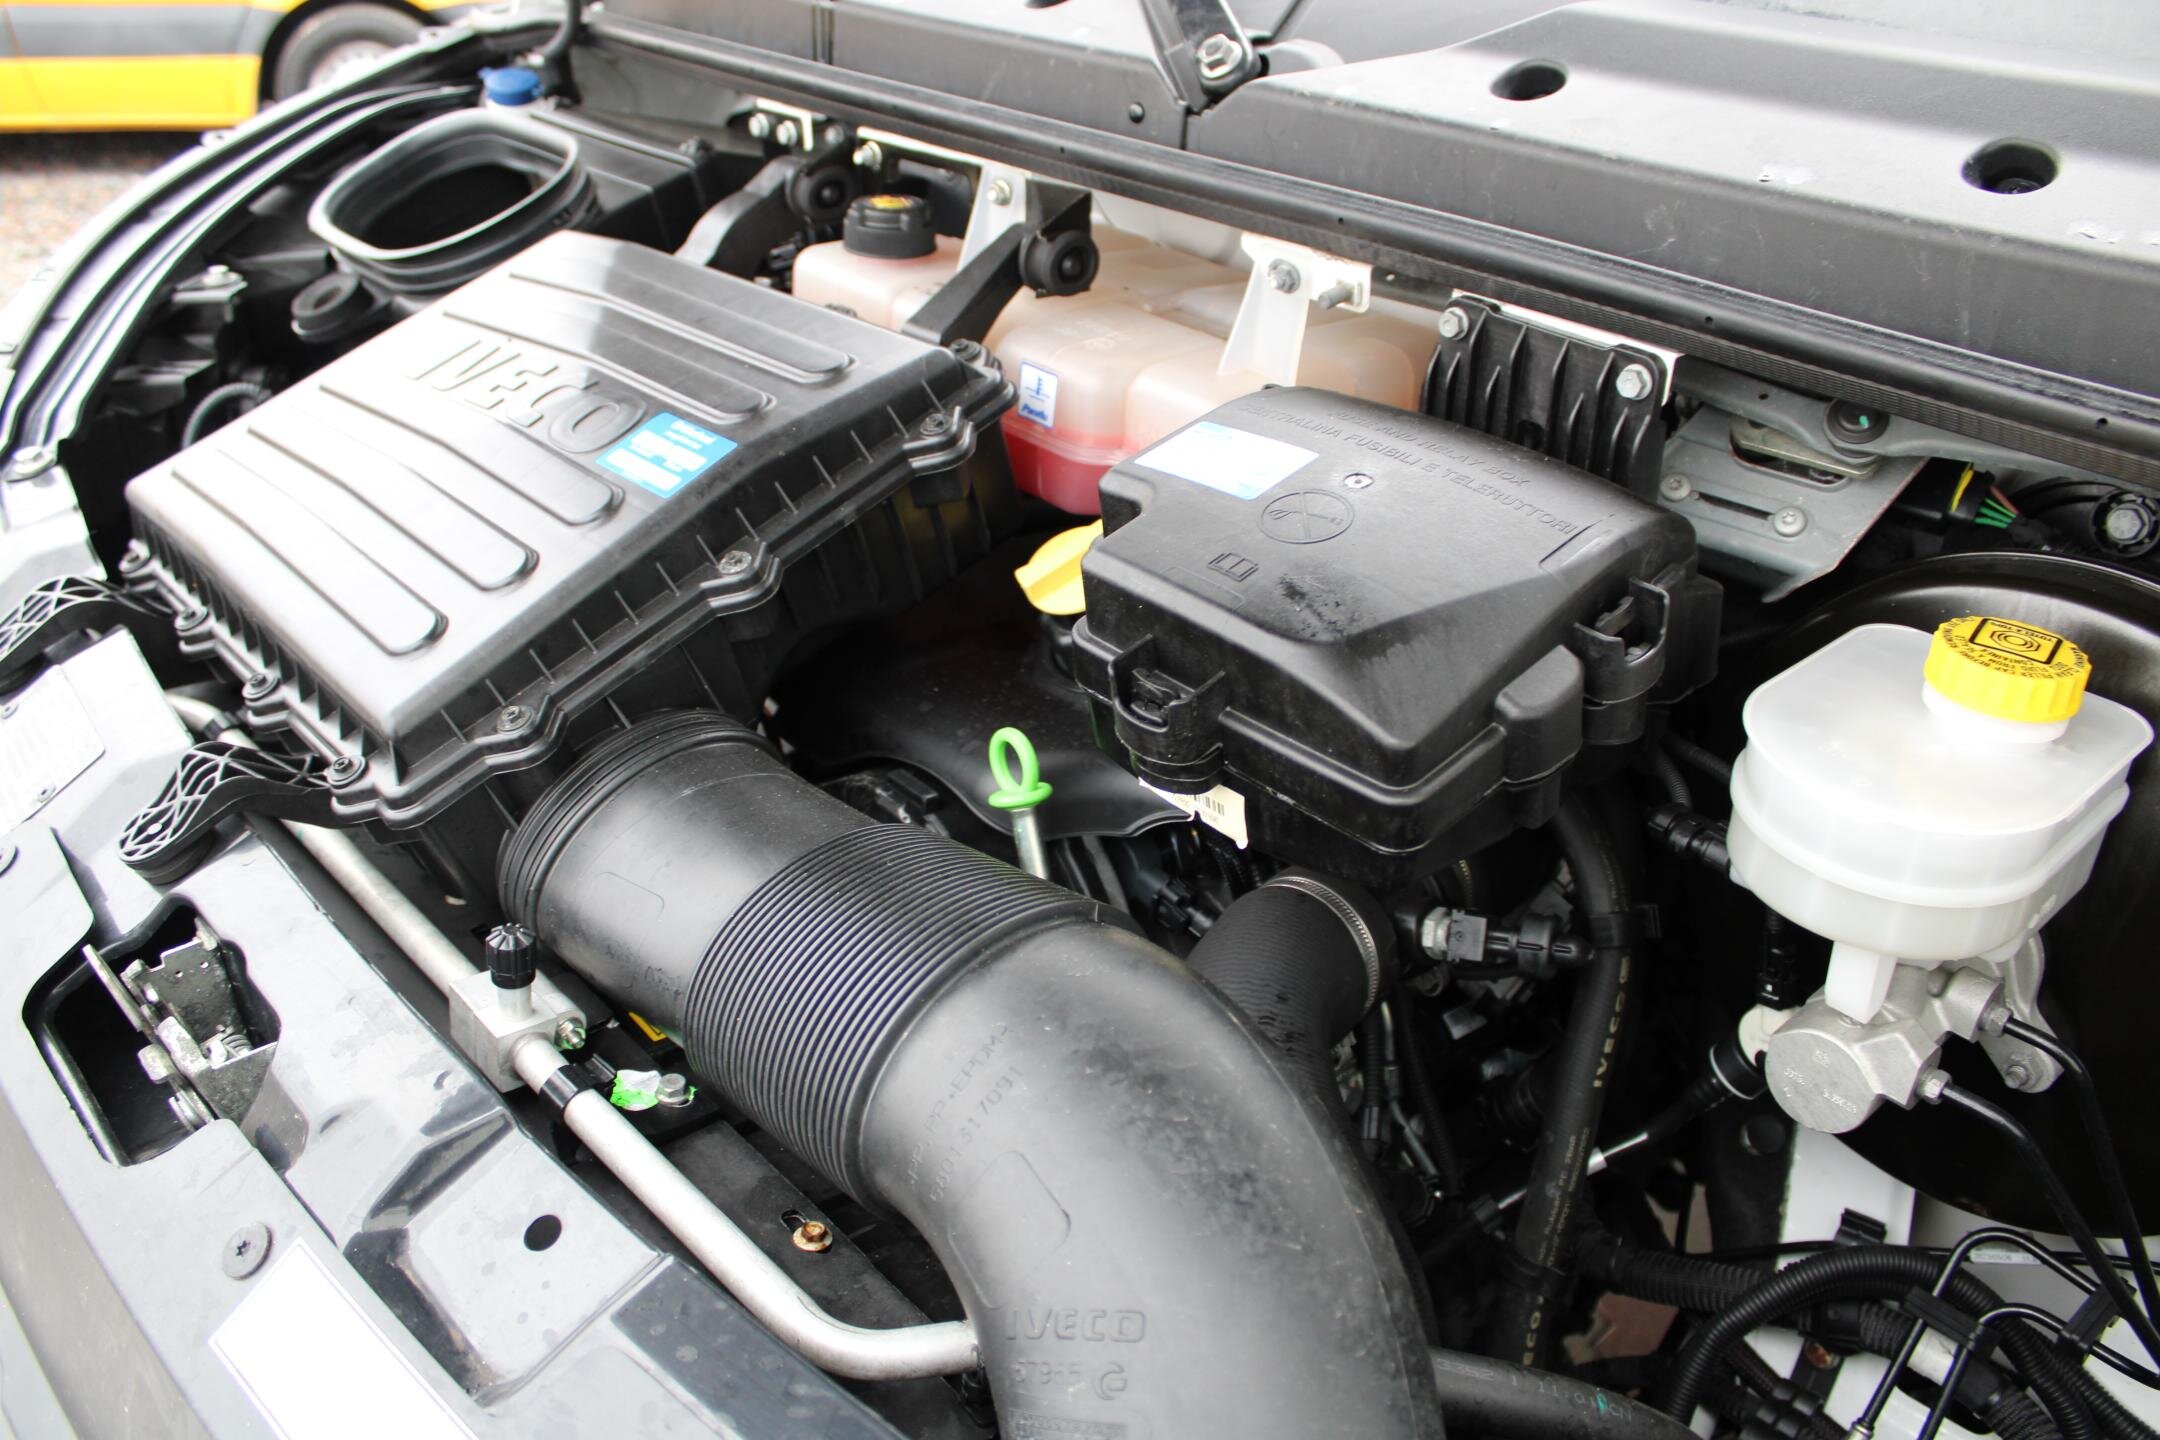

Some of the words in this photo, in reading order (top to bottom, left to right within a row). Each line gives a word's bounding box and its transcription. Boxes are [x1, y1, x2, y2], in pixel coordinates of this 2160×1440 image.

[404, 340, 648, 454] IVECO
[1239, 403, 1345, 438] CENTRALINA
[1344, 433, 1423, 467] FUSIBILI
[1442, 468, 1578, 535] TELERUTTORI
[1376, 424, 1418, 443] AND
[1418, 440, 1485, 467] RELAY
[1484, 466, 1531, 488] BOX
[1592, 990, 1628, 1089] IVECO
[1005, 1308, 1147, 1343] IVECO
